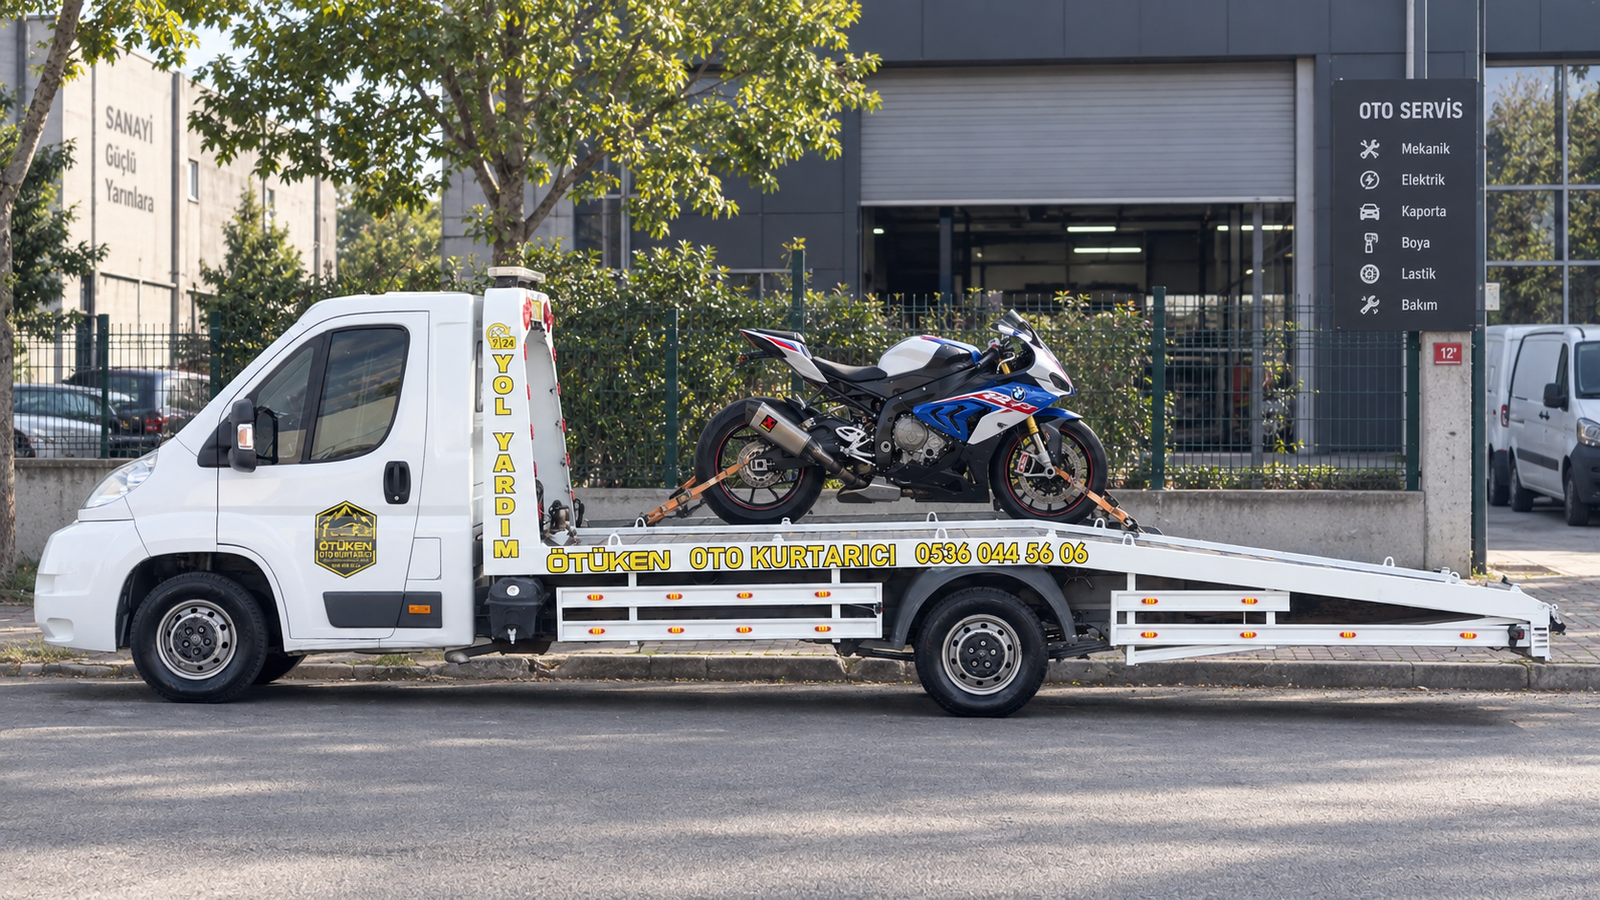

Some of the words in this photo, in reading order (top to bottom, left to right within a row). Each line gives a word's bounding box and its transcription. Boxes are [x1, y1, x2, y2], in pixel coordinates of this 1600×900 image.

[1359, 101, 1394, 119] OTO
[1400, 97, 1463, 119] SERVİS
[105, 105, 153, 144] SANAYİ
[1401, 142, 1451, 155] Mekanik
[105, 143, 136, 177] Güçlü
[1401, 173, 1445, 186] Elektrik
[105, 178, 154, 213] Yarınlara
[1401, 205, 1447, 220] Kaporta
[1401, 237, 1431, 251] Boya
[1401, 267, 1436, 280] Lastik
[1401, 298, 1438, 311] Bakım
[492, 354, 515, 415] YOL
[492, 432, 519, 558] YARDIM
[546, 547, 671, 573] ÖTÜKEN
[689, 546, 744, 570] OTO
[750, 543, 897, 569] KURTARICI
[915, 541, 972, 565] 0536
[977, 541, 1020, 564] 044
[1025, 541, 1053, 565] 56
[1059, 541, 1089, 565] 06
